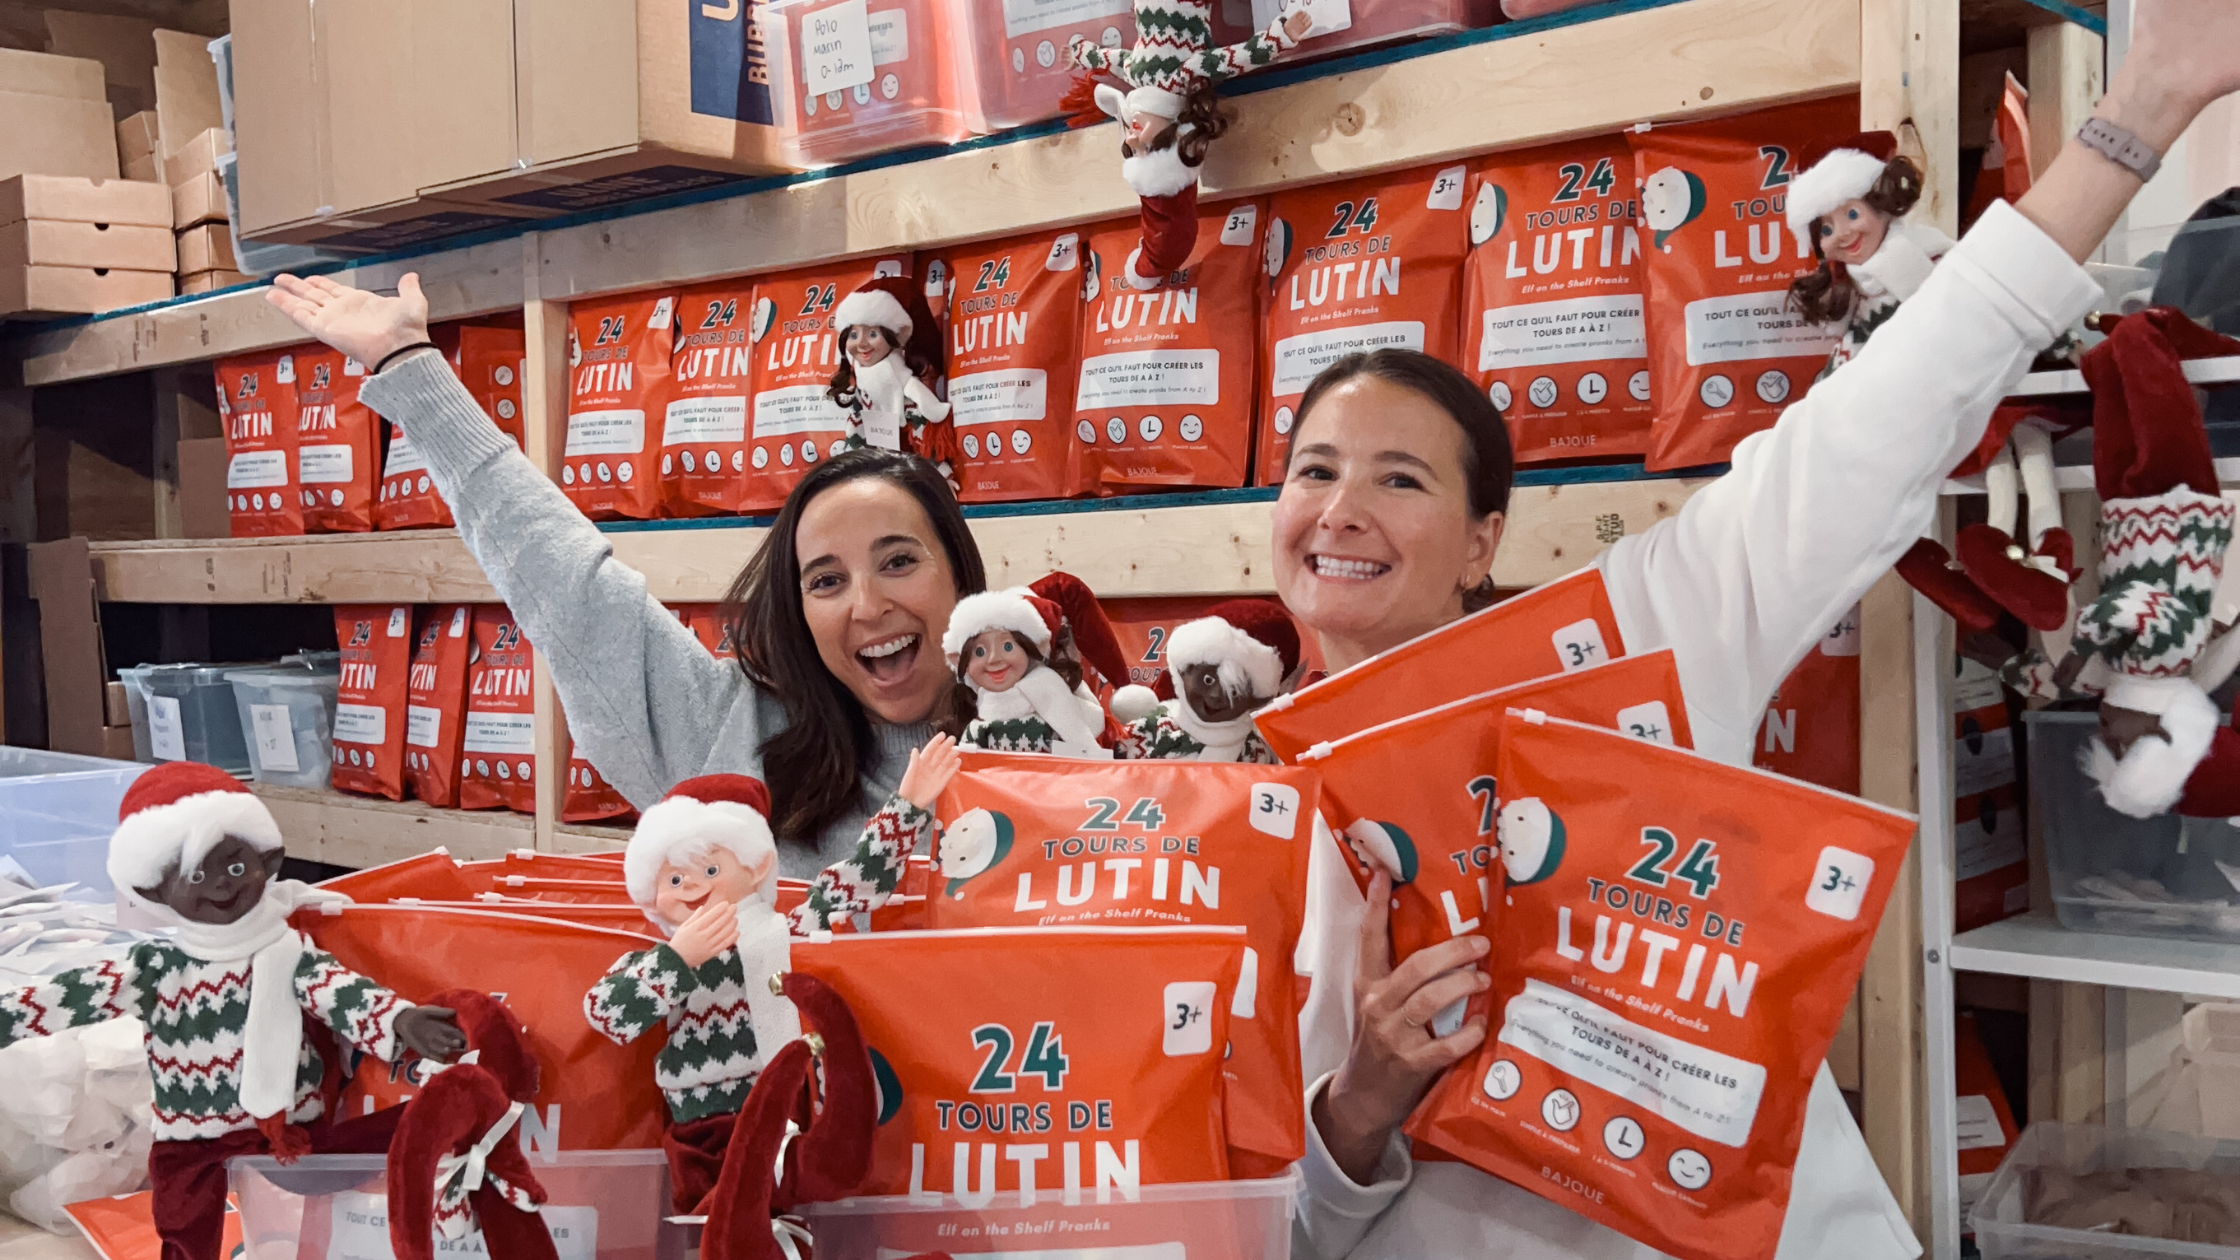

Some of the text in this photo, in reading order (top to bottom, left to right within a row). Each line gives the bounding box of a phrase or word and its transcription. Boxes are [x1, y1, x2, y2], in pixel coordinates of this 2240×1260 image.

[1435, 179, 1456, 194] 3+
[1550, 157, 1616, 203] 24
[1229, 216, 1248, 231] 3+
[1325, 197, 1378, 239] 24
[1525, 204, 1599, 230] TOURS
[1053, 244, 1071, 258] 3+
[1305, 236, 1391, 264] TOURS DE
[931, 270, 945, 284] 3+
[973, 256, 1011, 293] 24
[1170, 268, 1189, 285] DE
[1290, 257, 1400, 311] LUTIN
[1522, 284, 1533, 293] Elf
[1550, 282, 1565, 290] the
[1568, 278, 1591, 289] Shelf
[1594, 276, 1629, 285] Pranks
[699, 298, 737, 329] 24
[799, 283, 836, 317] 24
[960, 292, 1018, 315] TOURS DE
[1096, 287, 1198, 333] LUTIN
[783, 318, 821, 334] TOURS
[1492, 320, 1513, 329] TOUT
[1517, 318, 1528, 327] CE
[1556, 313, 1578, 322] FAUT
[1582, 311, 1606, 320] POUR
[1705, 310, 1732, 320] TOUT
[1736, 309, 1749, 317] CE
[1758, 320, 1792, 329] TOURS
[595, 315, 625, 346] 24
[686, 330, 744, 347] TOURS DE
[954, 312, 1028, 356] LUTIN
[1344, 340, 1364, 348] POUR
[1533, 328, 1563, 338] TOURS
[1566, 326, 1576, 335] DE
[677, 346, 749, 382] LUTIN
[237, 372, 258, 399] 24
[576, 362, 633, 396] LUTIN
[1550, 435, 1596, 448] BAJOUE
[490, 623, 520, 651] 24
[1566, 641, 1595, 666] 3+
[472, 669, 531, 696] LUTIN
[1076, 796, 1166, 831] 24
[1260, 792, 1289, 815] 3+
[1042, 836, 1201, 860] TOURS DE
[1624, 826, 1720, 900] 24
[1014, 858, 1220, 912] LUTIN
[1821, 865, 1857, 893] 3+
[1038, 908, 1191, 927] Elf on the Shelf Pranks
[1586, 876, 1746, 946] TOURS DE
[1556, 906, 1759, 1019] LUTIN
[1172, 1003, 1202, 1030] 3+
[1604, 988, 1624, 1002] the
[1626, 995, 1662, 1015] Shelf
[1662, 1008, 1710, 1032] Pranks
[1572, 1026, 1612, 1050] TOURS
[1615, 1044, 1629, 1059] DE
[968, 1021, 1069, 1094] 24
[1638, 1042, 1669, 1063] POUR
[1672, 1060, 1711, 1081] CRÉER
[1714, 1074, 1737, 1089] LES
[935, 1100, 1113, 1133] TOURS DE
[909, 1139, 1140, 1210] LUTIN
[1541, 1166, 1605, 1205] BAJOUE
[370, 1216, 386, 1227] CE
[938, 1218, 1111, 1237] Elf on the Shelf Pranks
[440, 1240, 455, 1251] DE
